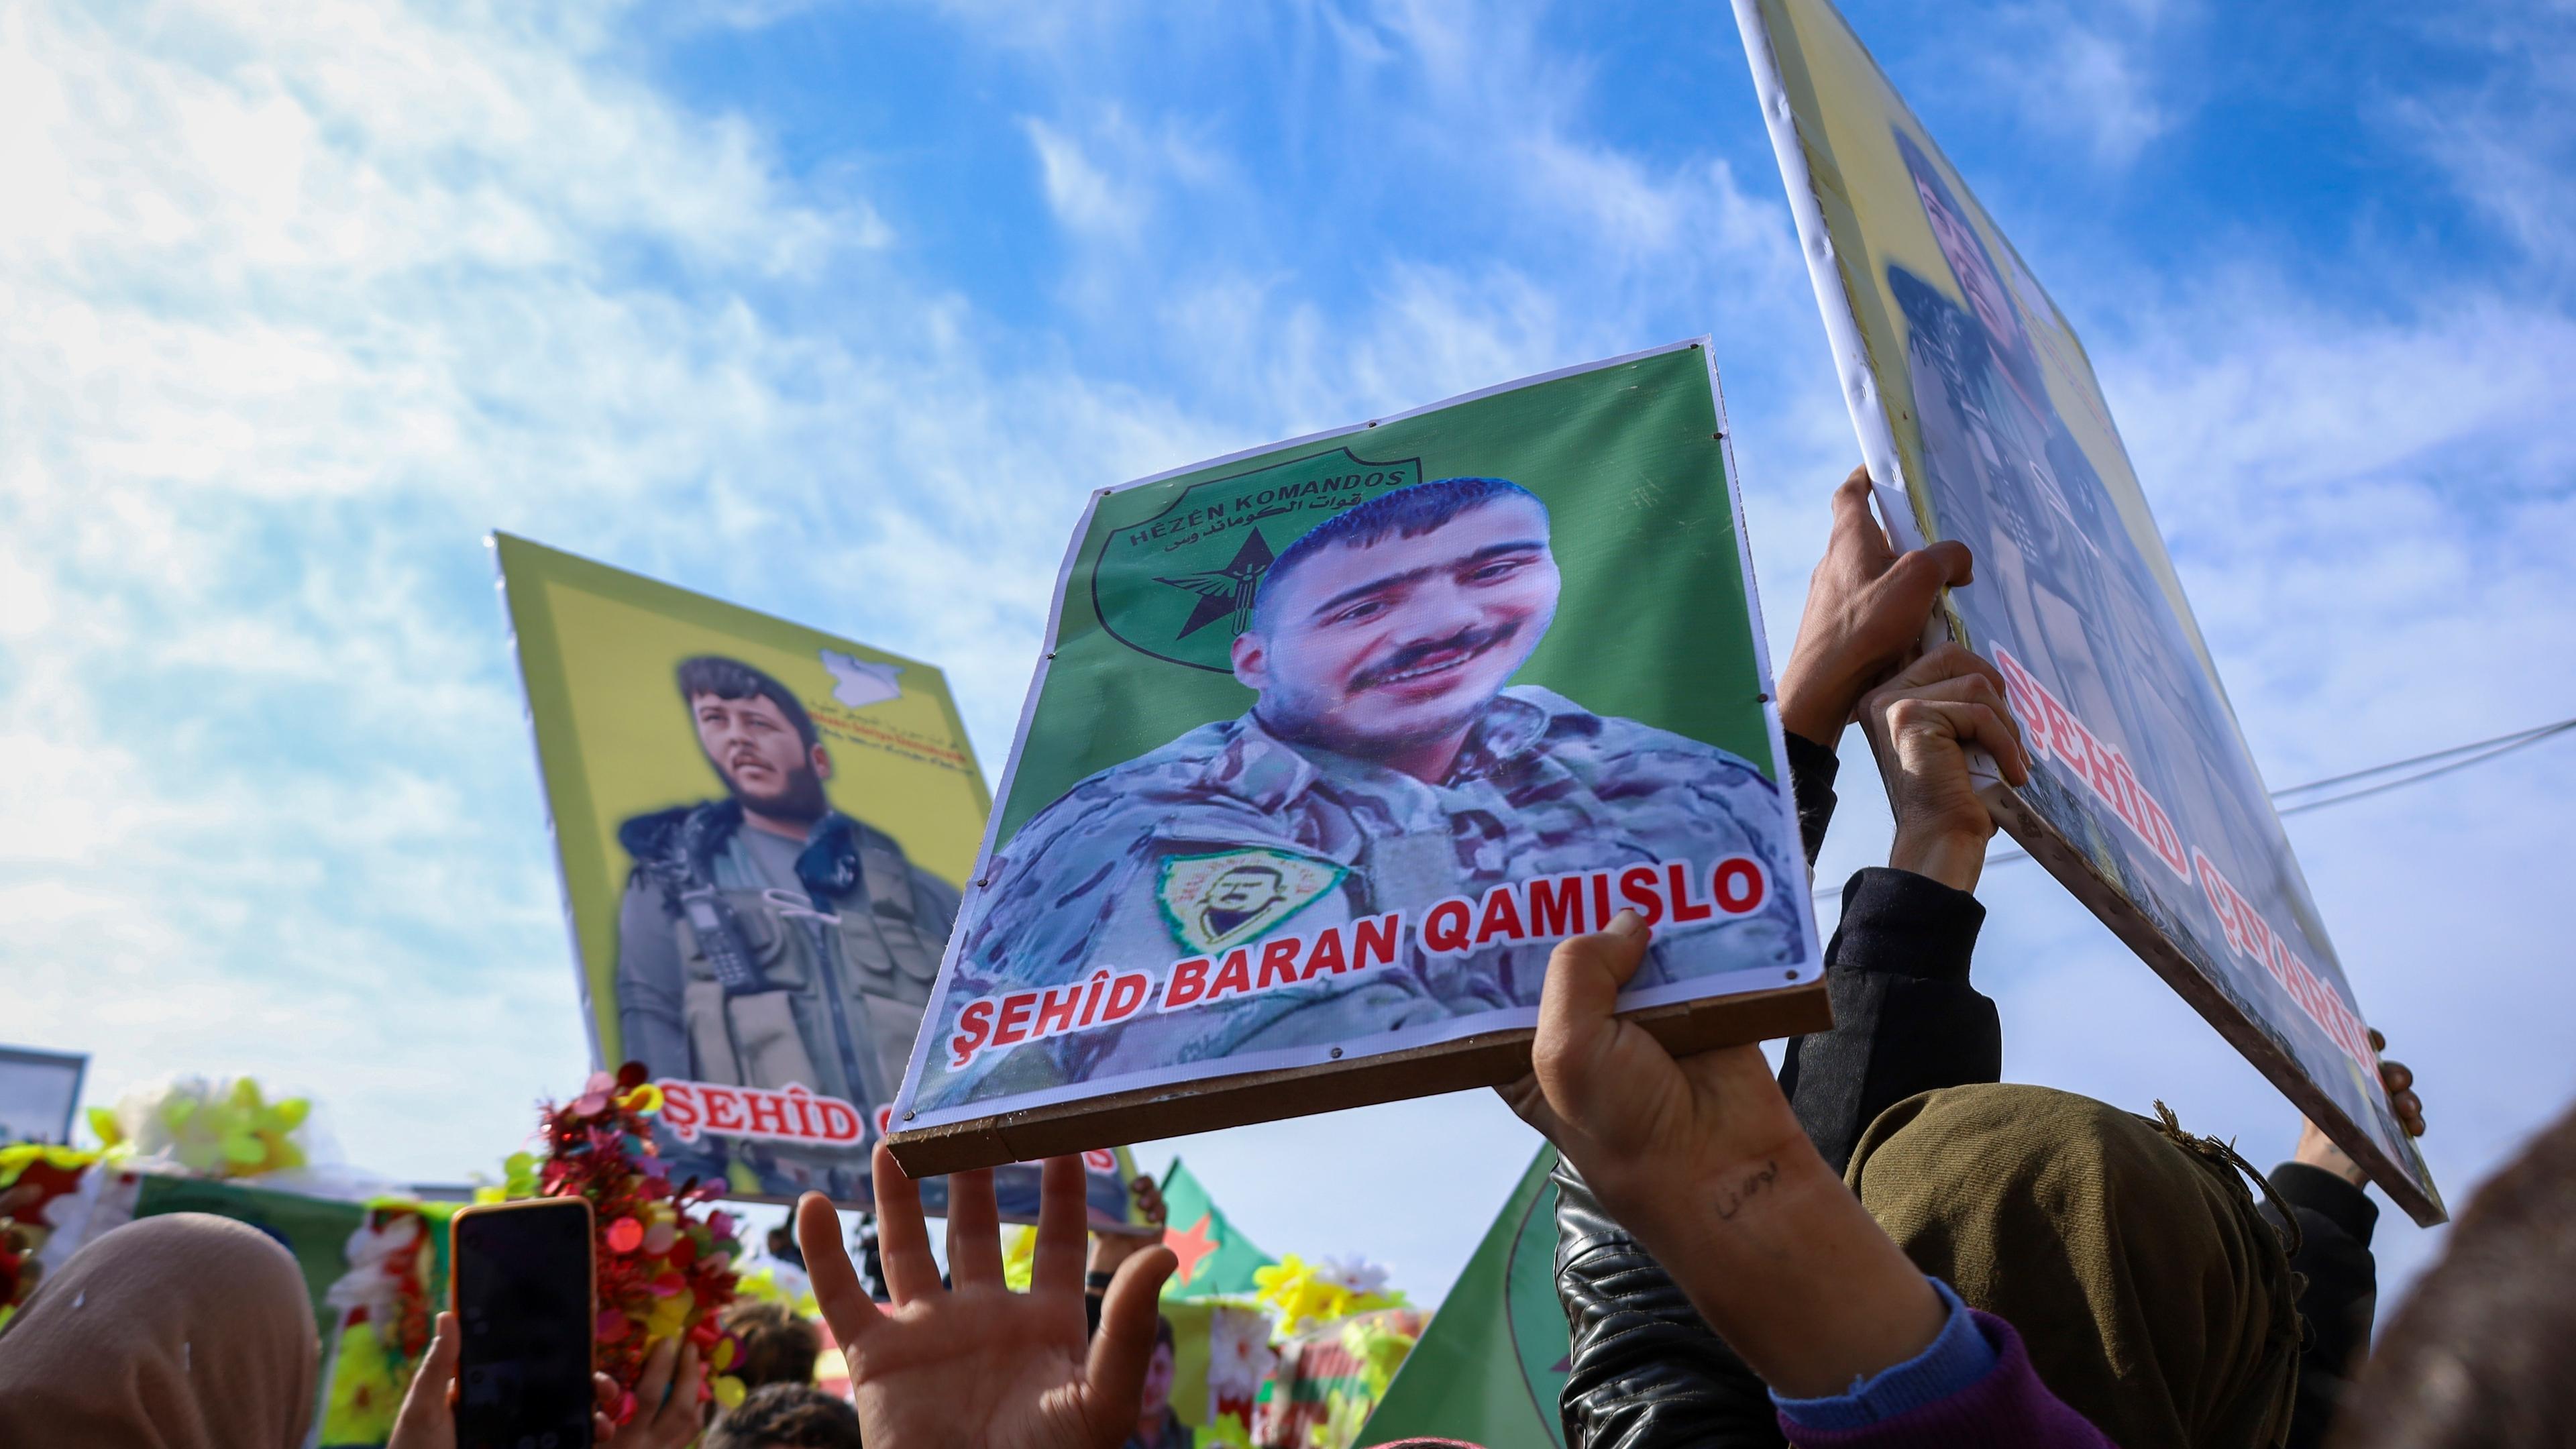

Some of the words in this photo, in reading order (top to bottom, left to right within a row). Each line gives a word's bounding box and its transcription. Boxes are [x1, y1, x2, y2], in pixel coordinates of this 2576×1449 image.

[1130, 503, 1224, 546] HÊZÊN
[1236, 471, 1406, 511] KOMANDOS
[1309, 493, 1362, 510] قوات
[1995, 649, 2187, 874] ŞEHÎD
[953, 971, 1146, 1067] ŞEHÎD
[1164, 914, 1399, 1008] BARAN
[660, 1083, 859, 1140] ŞEHÎD
